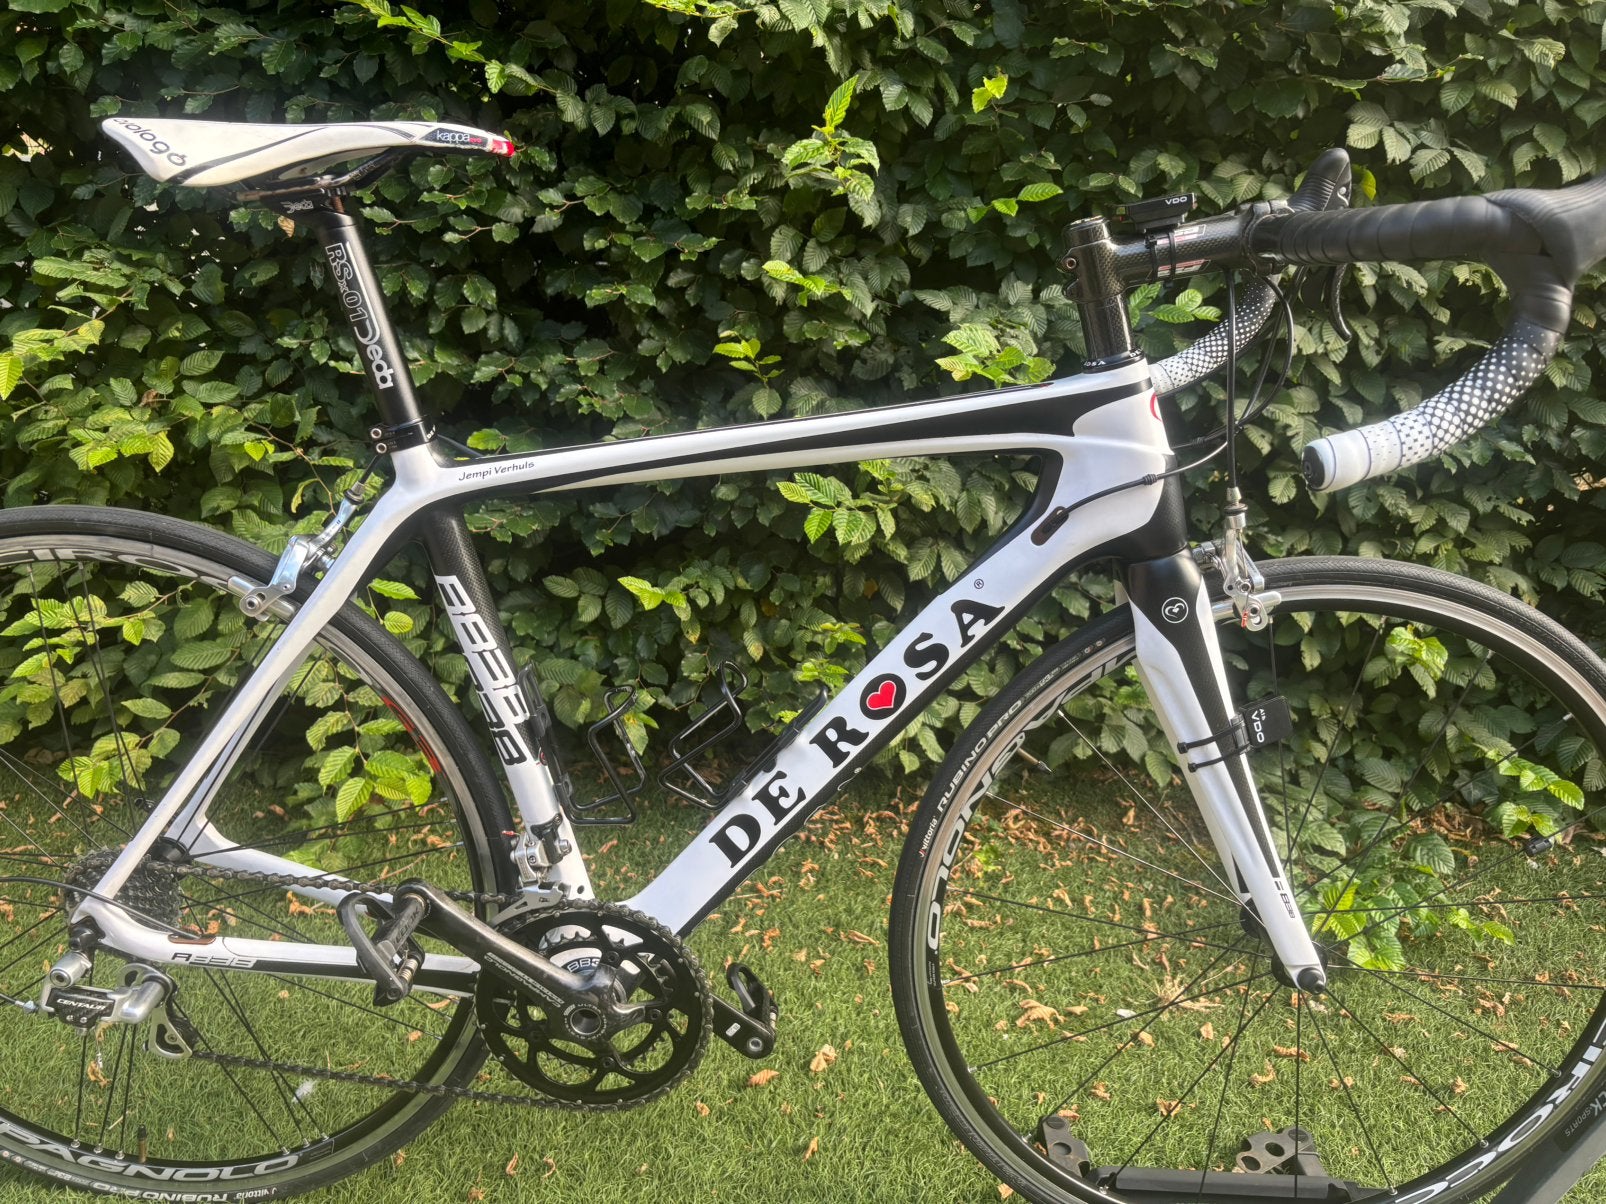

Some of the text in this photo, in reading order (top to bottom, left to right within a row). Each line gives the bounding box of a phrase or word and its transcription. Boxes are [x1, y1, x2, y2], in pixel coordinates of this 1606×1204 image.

[436, 130, 470, 144] kappa
[1164, 195, 1188, 206] VDO
[458, 460, 535, 481] Jempi Verhuls
[708, 598, 1006, 869] DE ROSA
[1251, 710, 1265, 743] VDO
[936, 737, 988, 814] RUBINO
[986, 699, 1023, 740] PRO
[566, 957, 601, 973] BB3
[56, 998, 107, 1011] CENTAUR
[92, 1182, 142, 1198] PRO
[142, 1190, 229, 1202] RUBINO
